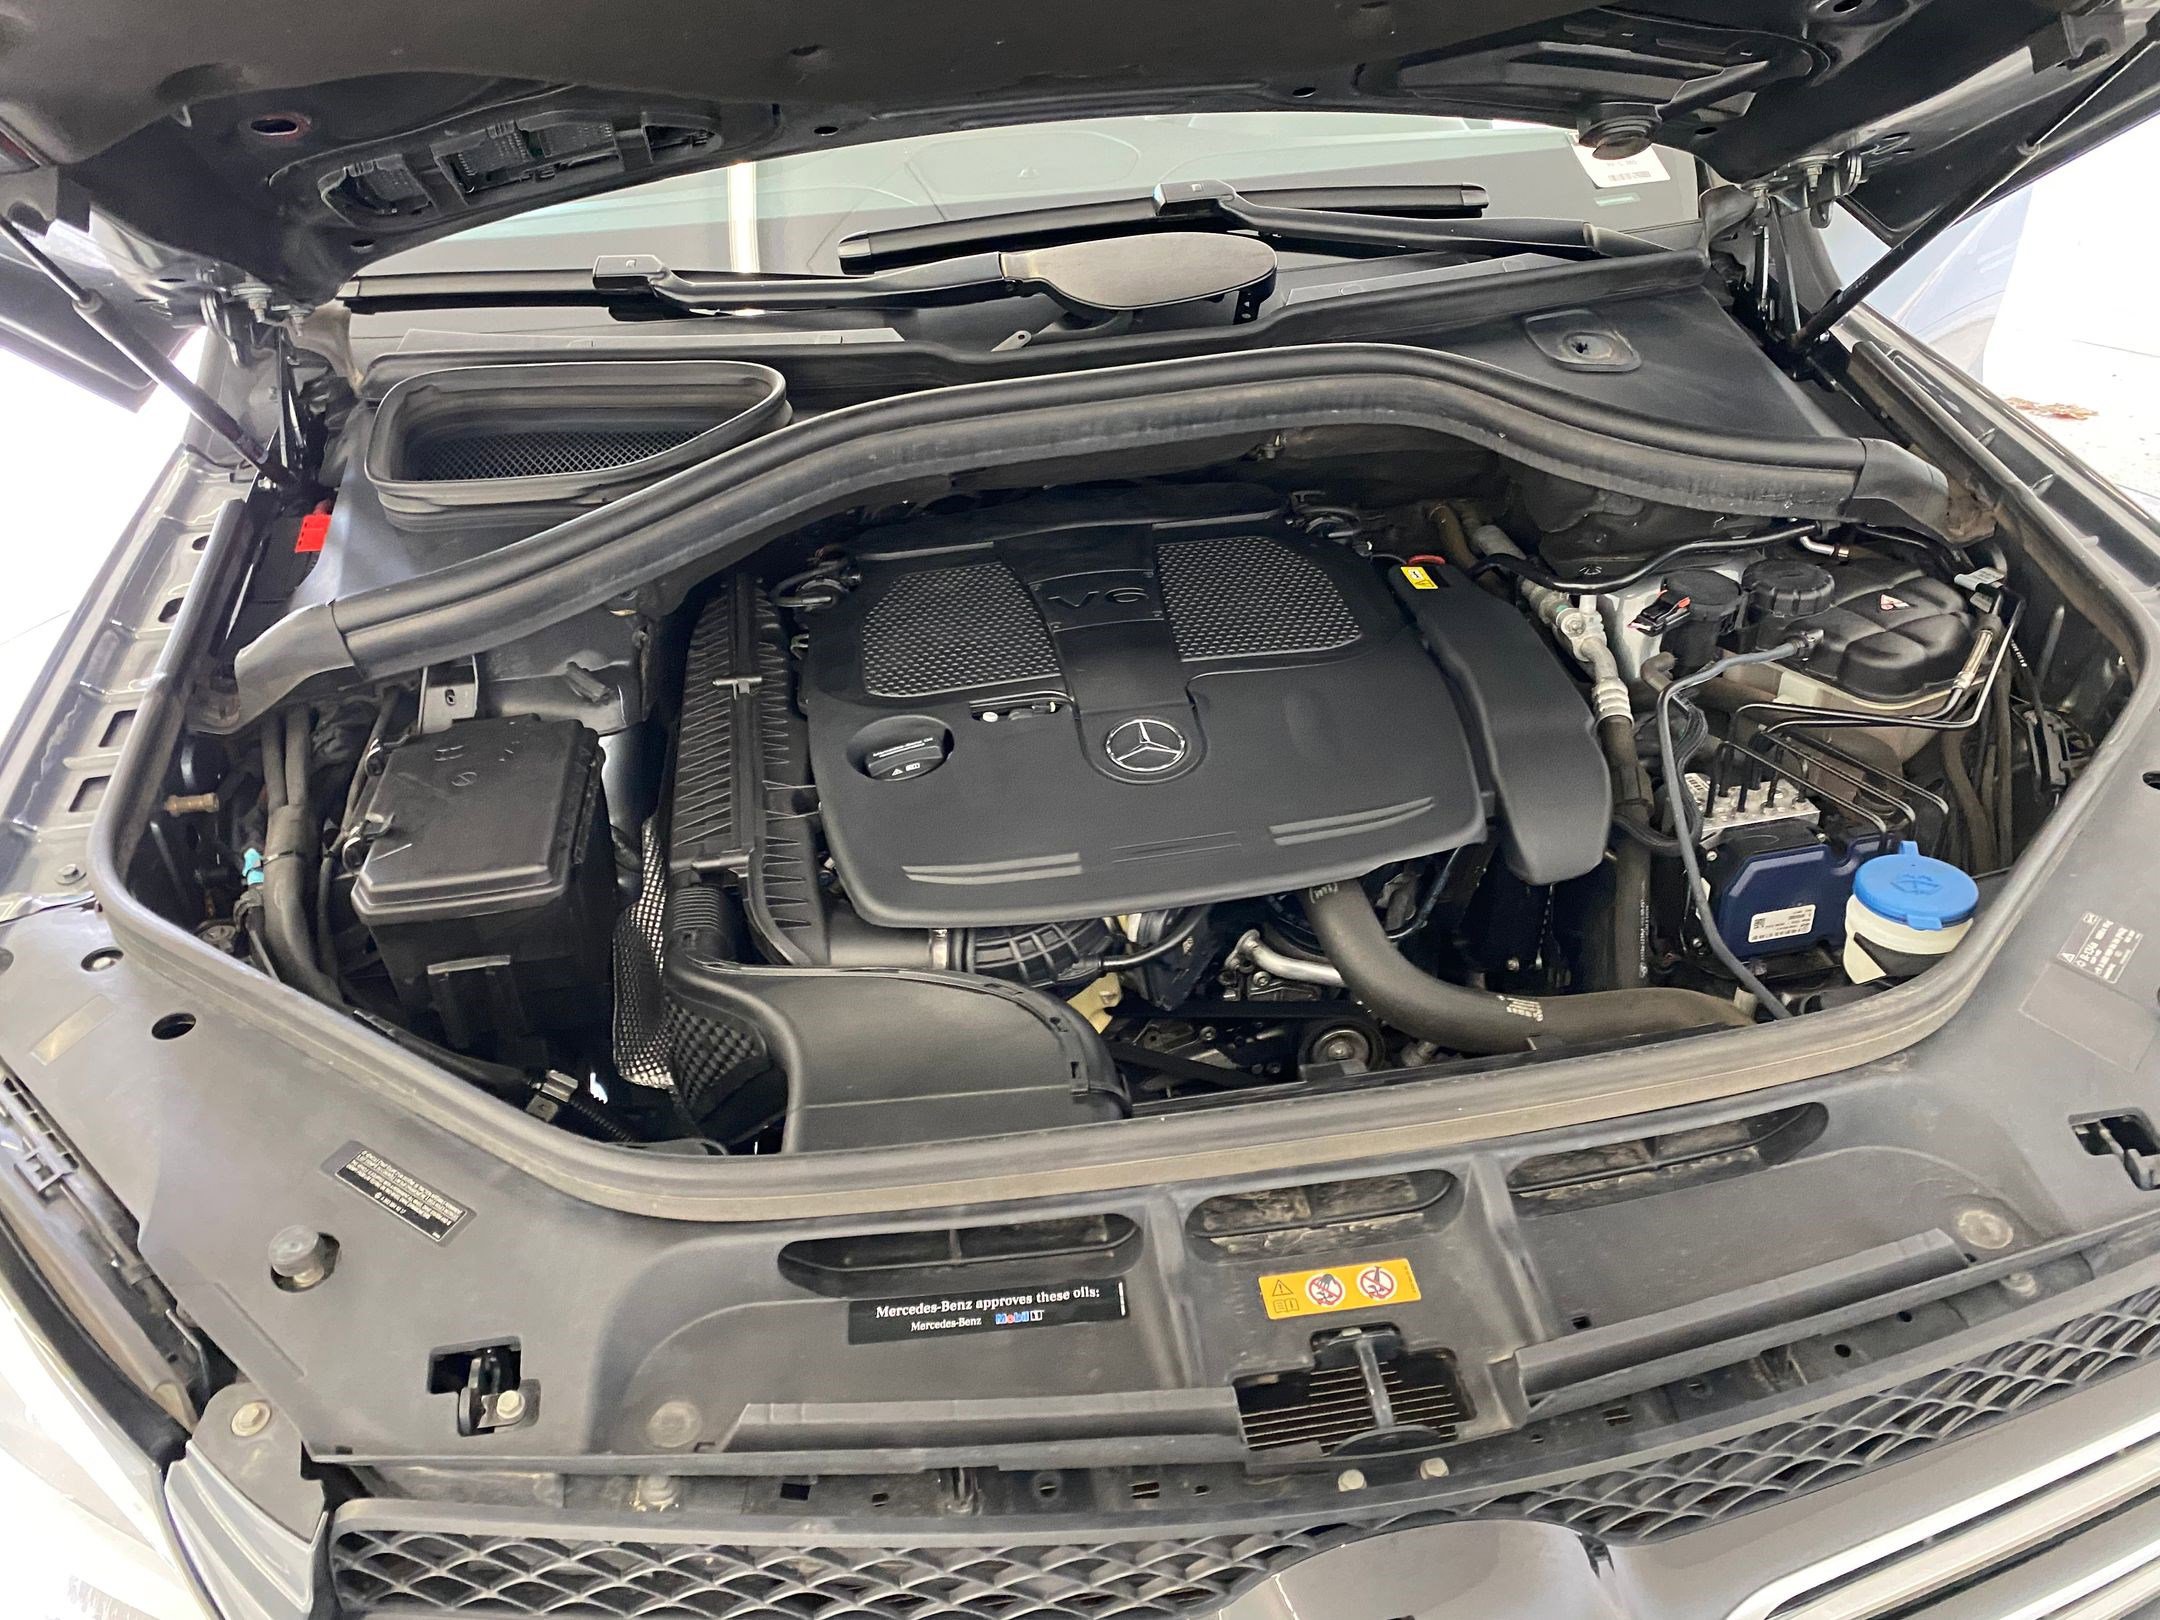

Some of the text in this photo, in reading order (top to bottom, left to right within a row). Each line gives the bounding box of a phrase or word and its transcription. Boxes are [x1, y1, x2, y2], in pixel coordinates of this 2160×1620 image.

[876, 1286, 1100, 1318] Mercedes-Benz approves these oils:
[911, 1317, 982, 1332] Mercedes-Benz
[995, 1311, 1029, 1325] Mobil
